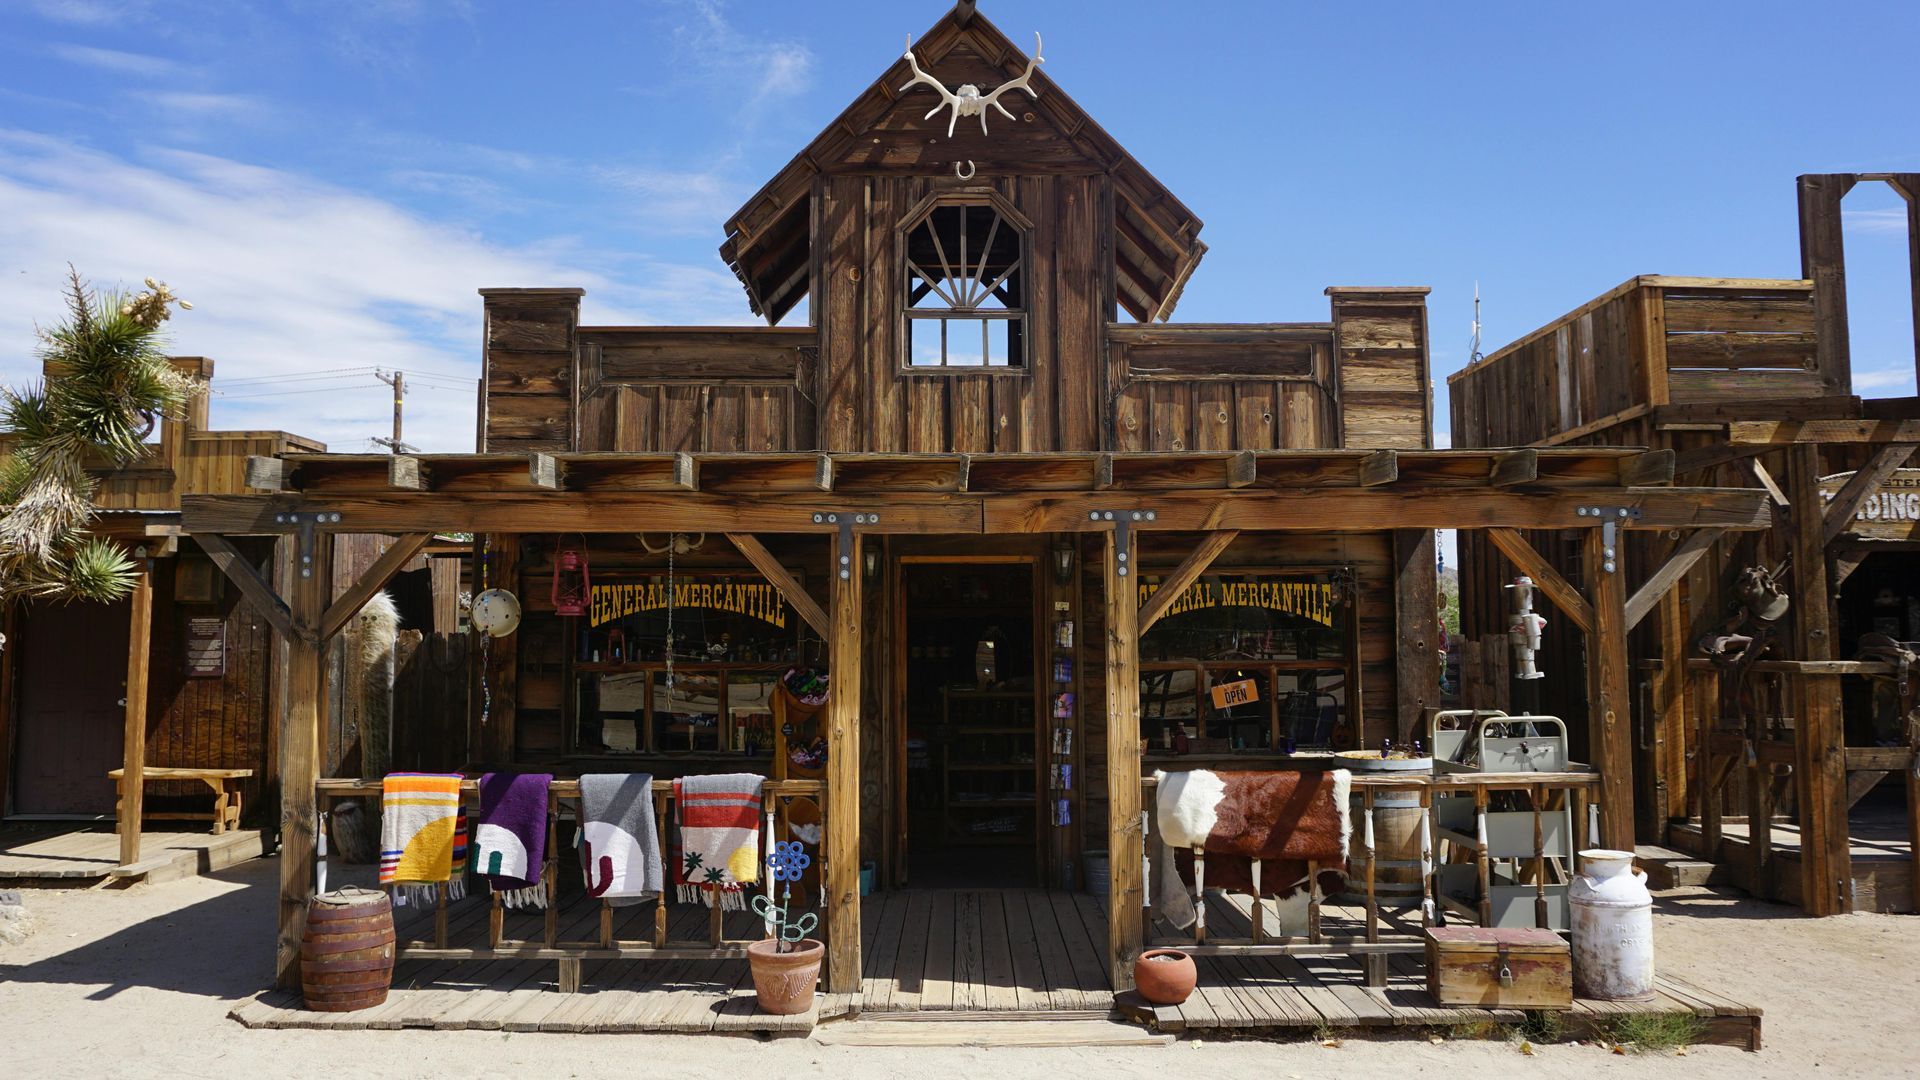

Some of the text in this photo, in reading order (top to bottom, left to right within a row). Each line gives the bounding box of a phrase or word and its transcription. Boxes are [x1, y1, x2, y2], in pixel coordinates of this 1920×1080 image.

[591, 583, 785, 629] GENERAL MERCANTILE
[1222, 583, 1332, 628] MERCANTILE
[1224, 687, 1248, 704] OPEN
